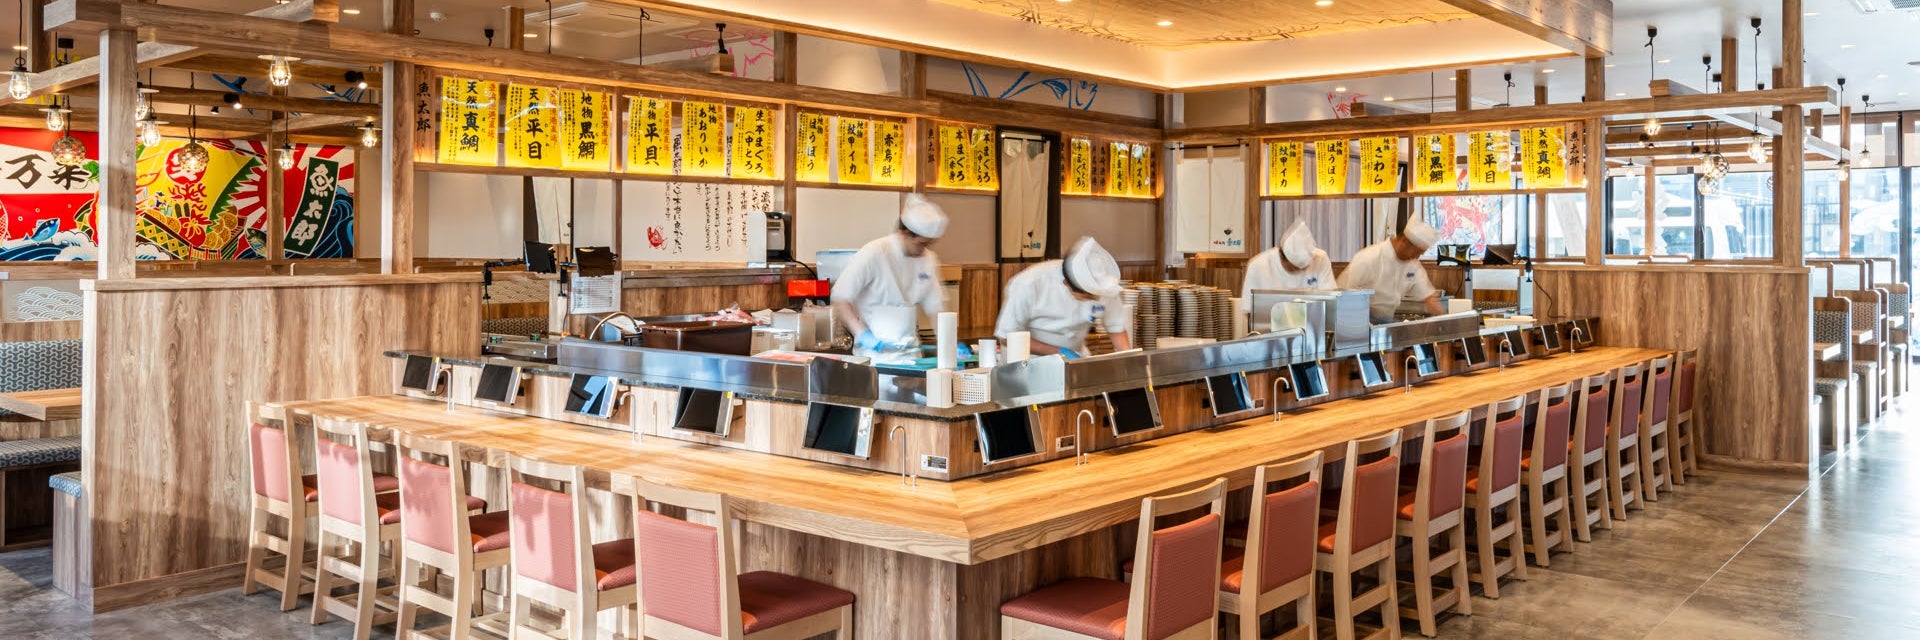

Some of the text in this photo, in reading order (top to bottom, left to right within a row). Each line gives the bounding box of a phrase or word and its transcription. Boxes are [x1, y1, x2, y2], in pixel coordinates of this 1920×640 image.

[416, 81, 431, 133] 魚太郎
[459, 80, 480, 153] 天然真鯛
[525, 87, 544, 160] 天然平目
[578, 92, 595, 160] 地物黒鯛
[644, 99, 660, 166] 地物平貝
[699, 107, 709, 168] あおりいか
[755, 109, 765, 174] 生本まぐろ
[1373, 146, 1385, 186] さわら
[1536, 128, 1551, 179] 天然真鯛
[1569, 130, 1580, 167] 魚太郎
[291, 163, 334, 247] 魚太郎
